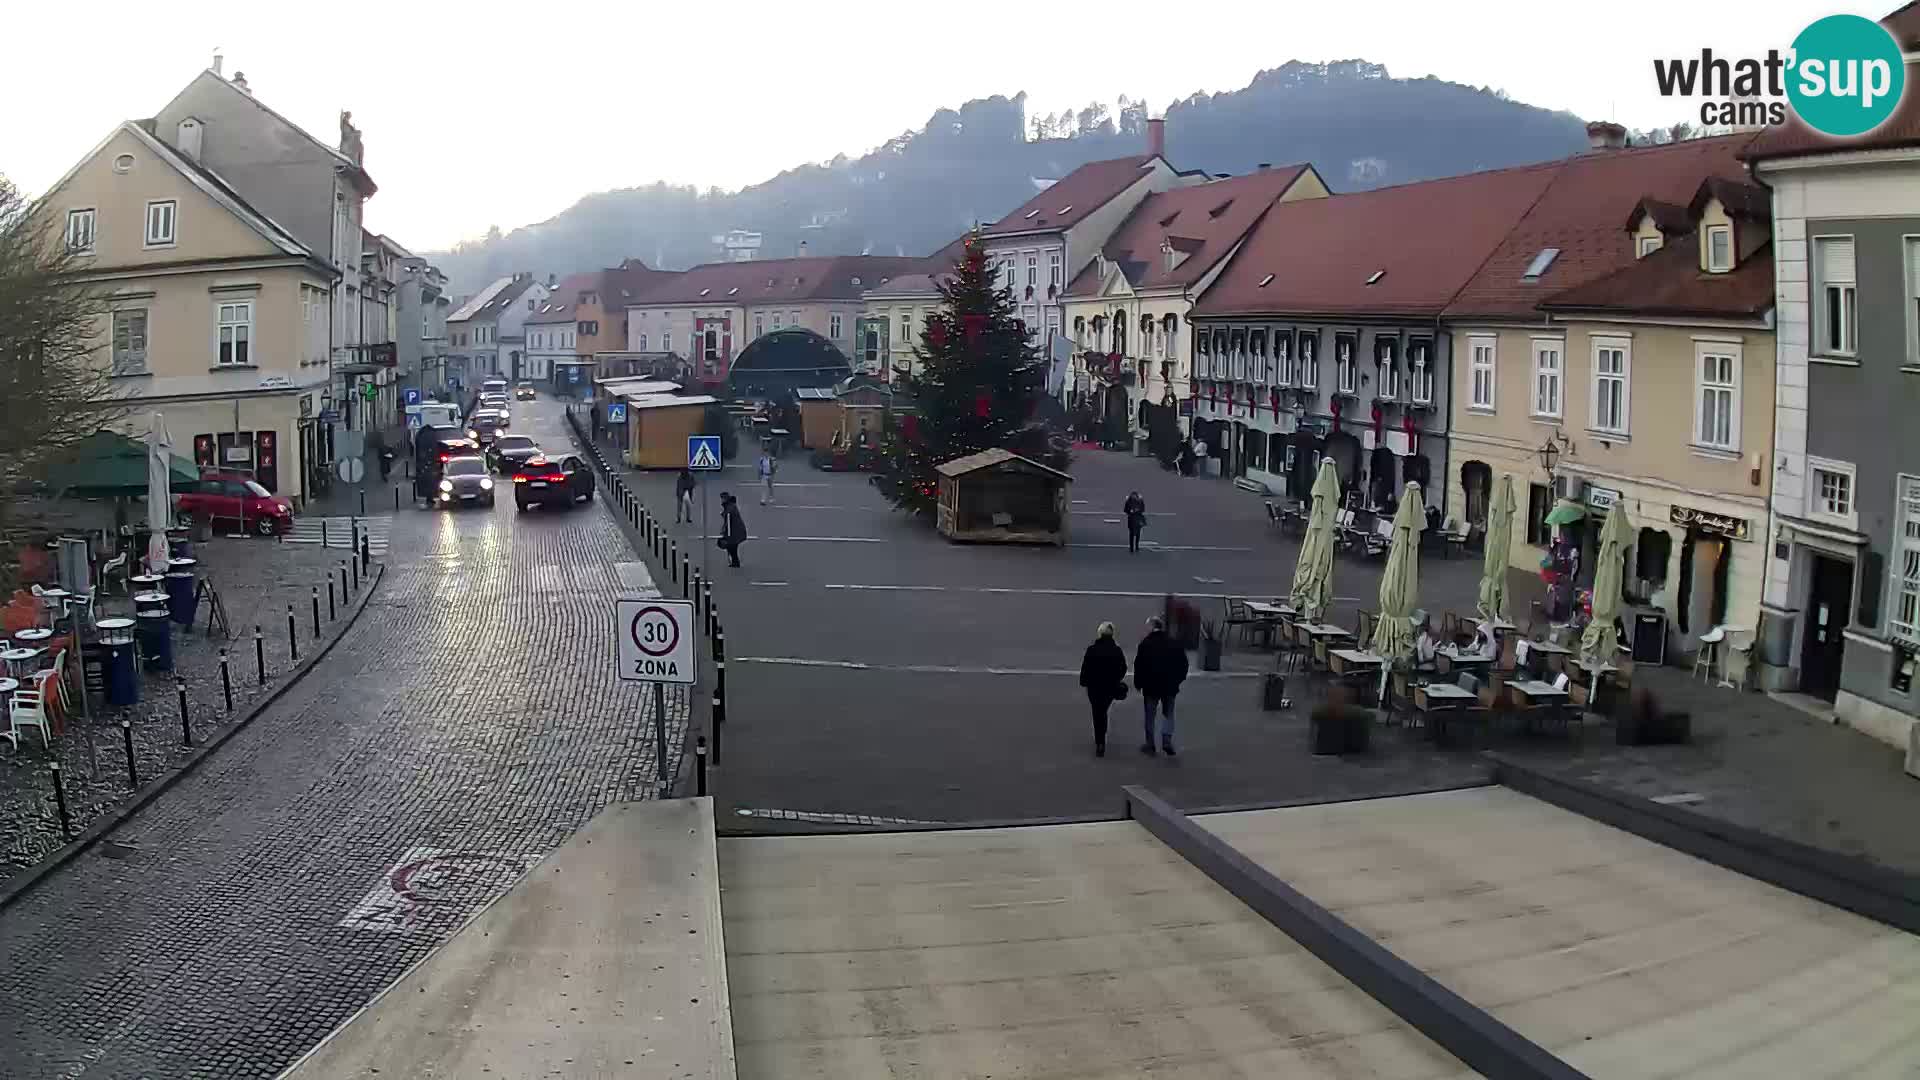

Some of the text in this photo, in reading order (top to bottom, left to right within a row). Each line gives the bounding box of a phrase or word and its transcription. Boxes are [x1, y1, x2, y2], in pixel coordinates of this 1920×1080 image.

[408, 391, 417, 402] P
[644, 622, 667, 643] 30
[634, 659, 678, 676] ZONA
